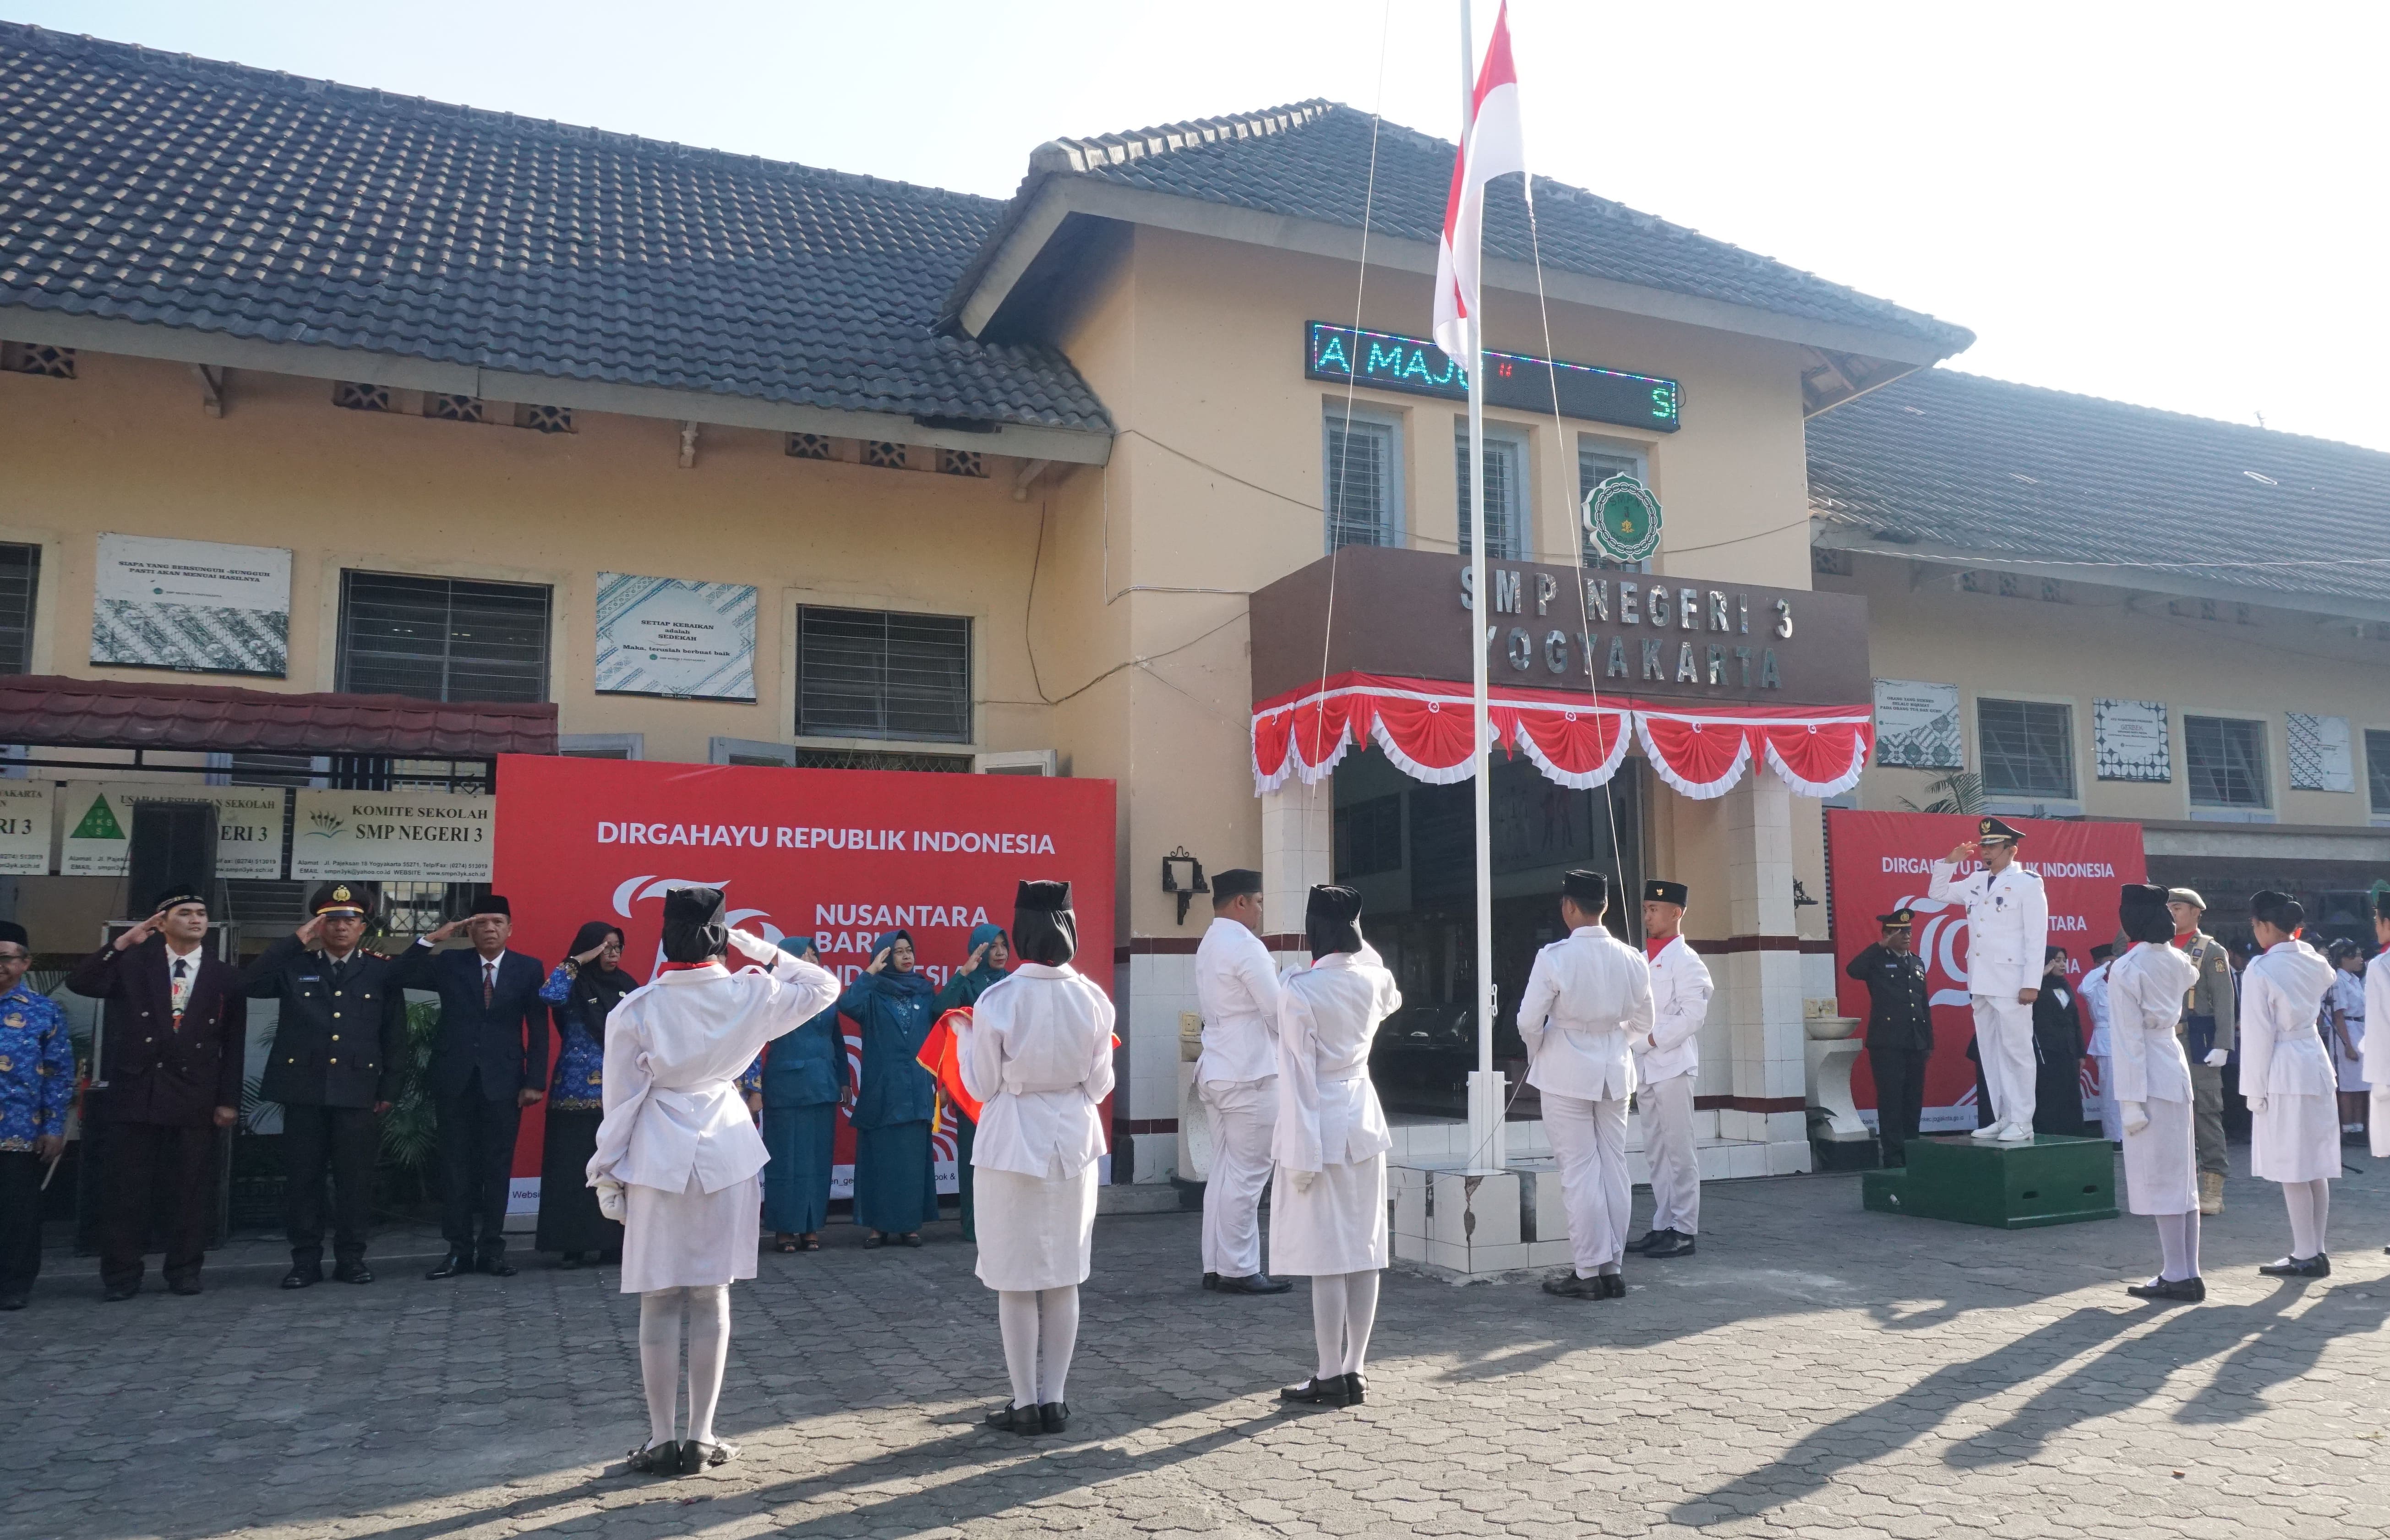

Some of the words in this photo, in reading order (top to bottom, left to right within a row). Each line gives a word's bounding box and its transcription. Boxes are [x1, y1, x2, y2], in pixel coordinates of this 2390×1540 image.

[1319, 336, 1350, 372] A
[1653, 388, 1670, 417] S
[1609, 494, 1642, 507] SMPN
[1461, 566, 1558, 616] SMP
[1584, 578, 1748, 634] NEGERI
[1774, 598, 1793, 638] 3
[225, 799, 275, 809] SEKOLAH
[352, 805, 413, 817] KOMITE
[417, 808, 488, 819] SEKOLAH
[22, 819, 32, 835] 3
[221, 825, 253, 841] ERI
[258, 826, 268, 841] 3
[356, 824, 395, 840] SMP
[398, 825, 469, 841] NEGERI
[474, 828, 482, 842] 3
[598, 822, 768, 847] DIRGAHAYU
[776, 827, 906, 851] REPUBLIK
[914, 831, 1056, 855] INDONESIA
[2042, 862, 2115, 878] INDONESIA
[816, 904, 989, 927] NUSANTARA
[815, 931, 879, 953] BAR
